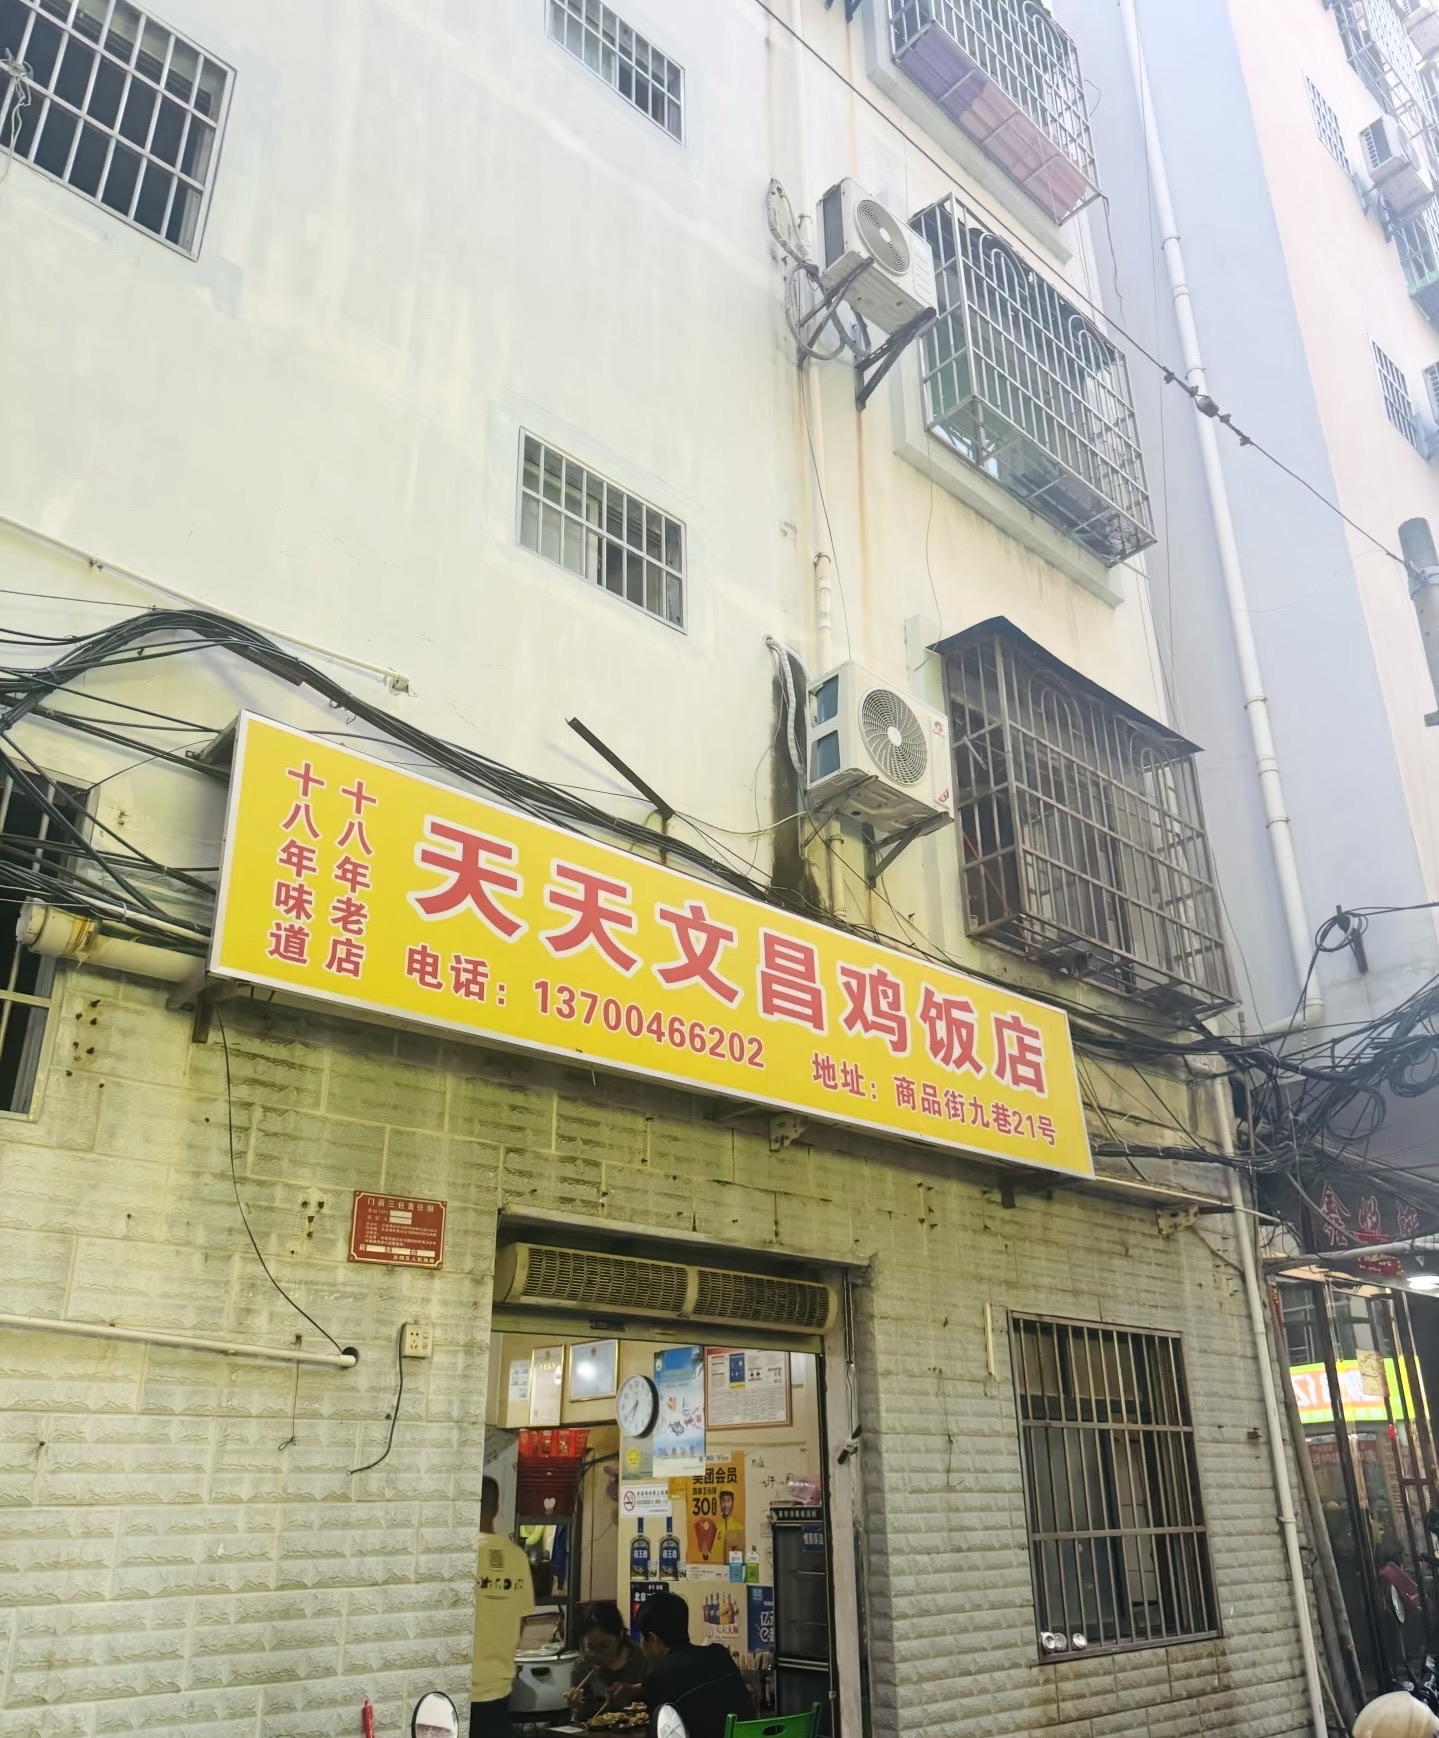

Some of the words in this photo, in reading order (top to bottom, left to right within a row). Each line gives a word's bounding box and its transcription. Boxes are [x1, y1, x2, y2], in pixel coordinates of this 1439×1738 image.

[268, 762, 325, 966] 十八年味道
[327, 781, 377, 978] 十八年老店
[413, 820, 1047, 1095] 天天文昌鸡饭店
